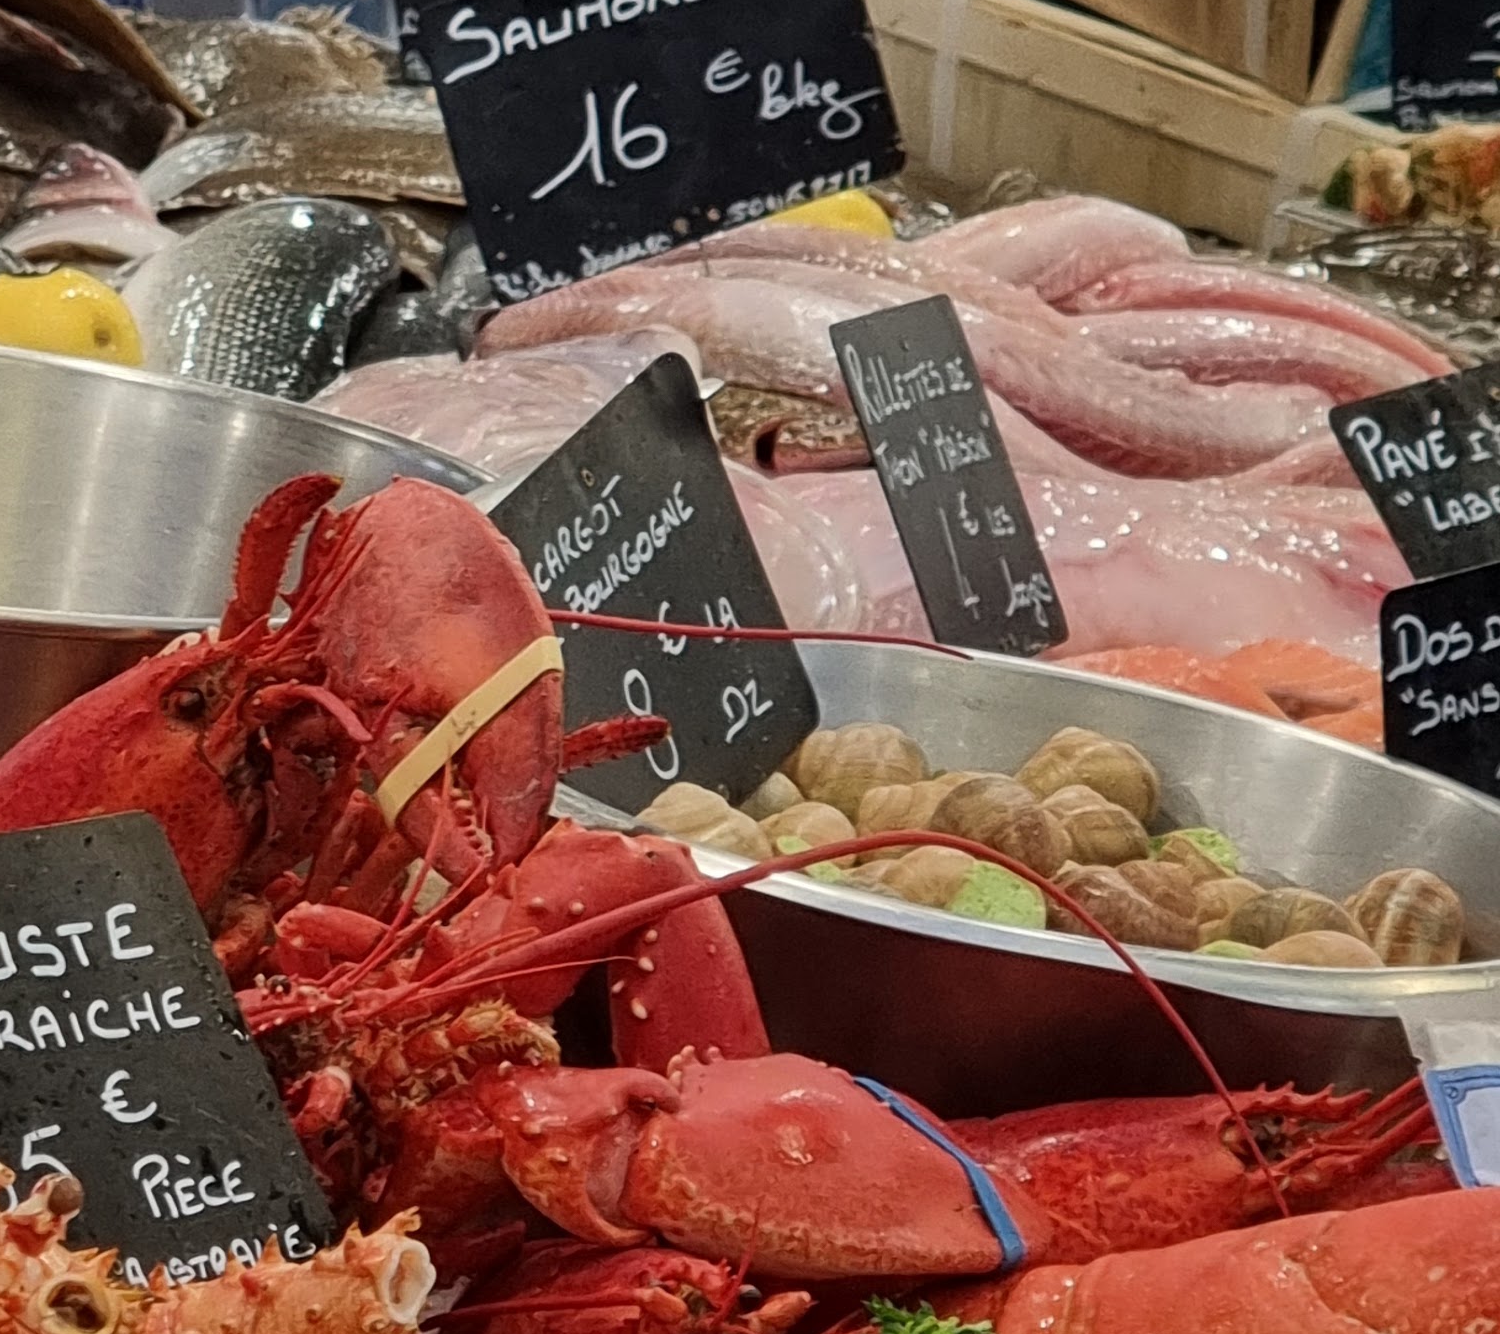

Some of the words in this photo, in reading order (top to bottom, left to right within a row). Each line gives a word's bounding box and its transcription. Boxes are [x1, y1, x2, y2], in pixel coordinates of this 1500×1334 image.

[529, 82, 668, 201] 16
[704, 47, 752, 94] €
[1347, 408, 1457, 483] PAVÉ
[533, 473, 623, 594] CARGOT
[1385, 612, 1475, 683] DOS
[100, 1069, 158, 1124] €
